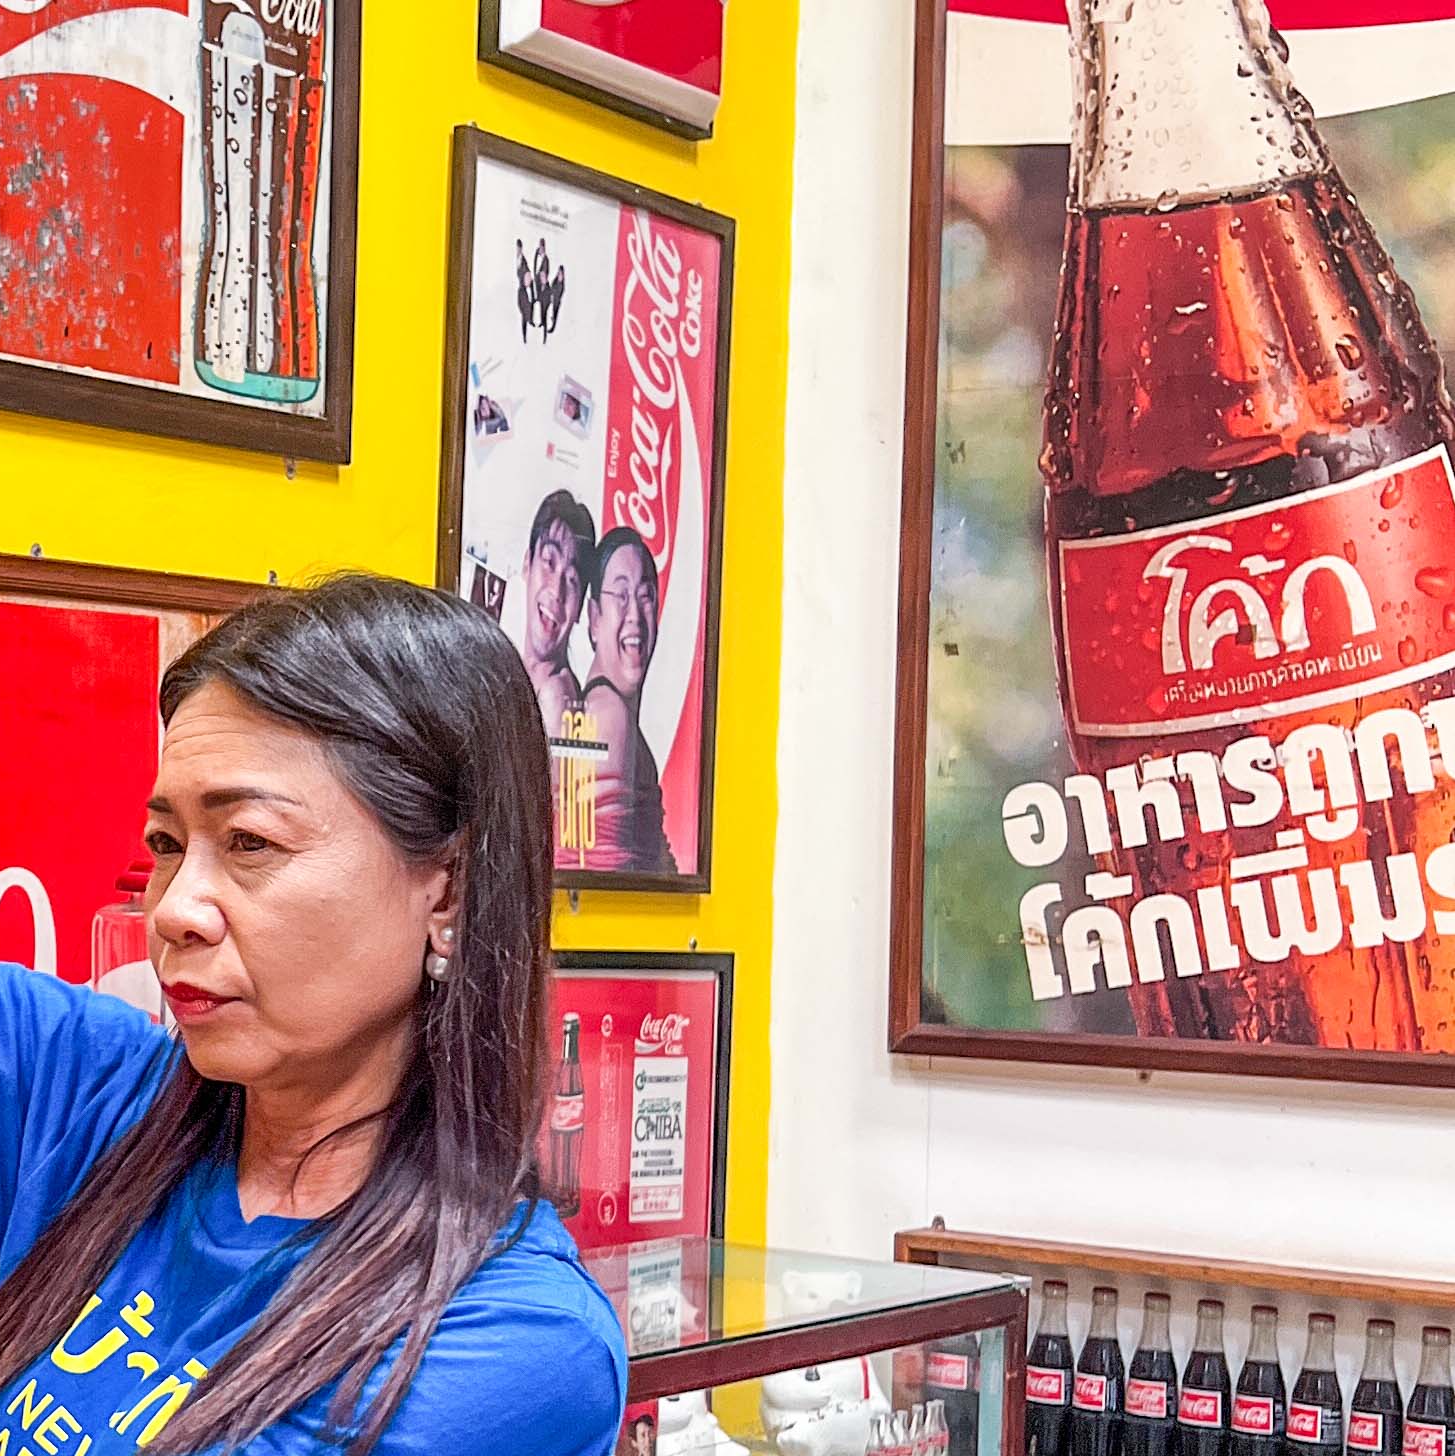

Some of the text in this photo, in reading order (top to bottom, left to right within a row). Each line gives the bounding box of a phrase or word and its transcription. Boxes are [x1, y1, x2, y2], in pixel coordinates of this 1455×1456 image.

[679, 268, 703, 358] Coke
[608, 427, 621, 479] Enjoy
[1142, 534, 1377, 675] โค้ก
[1002, 698, 1455, 868] อาหารถูก
